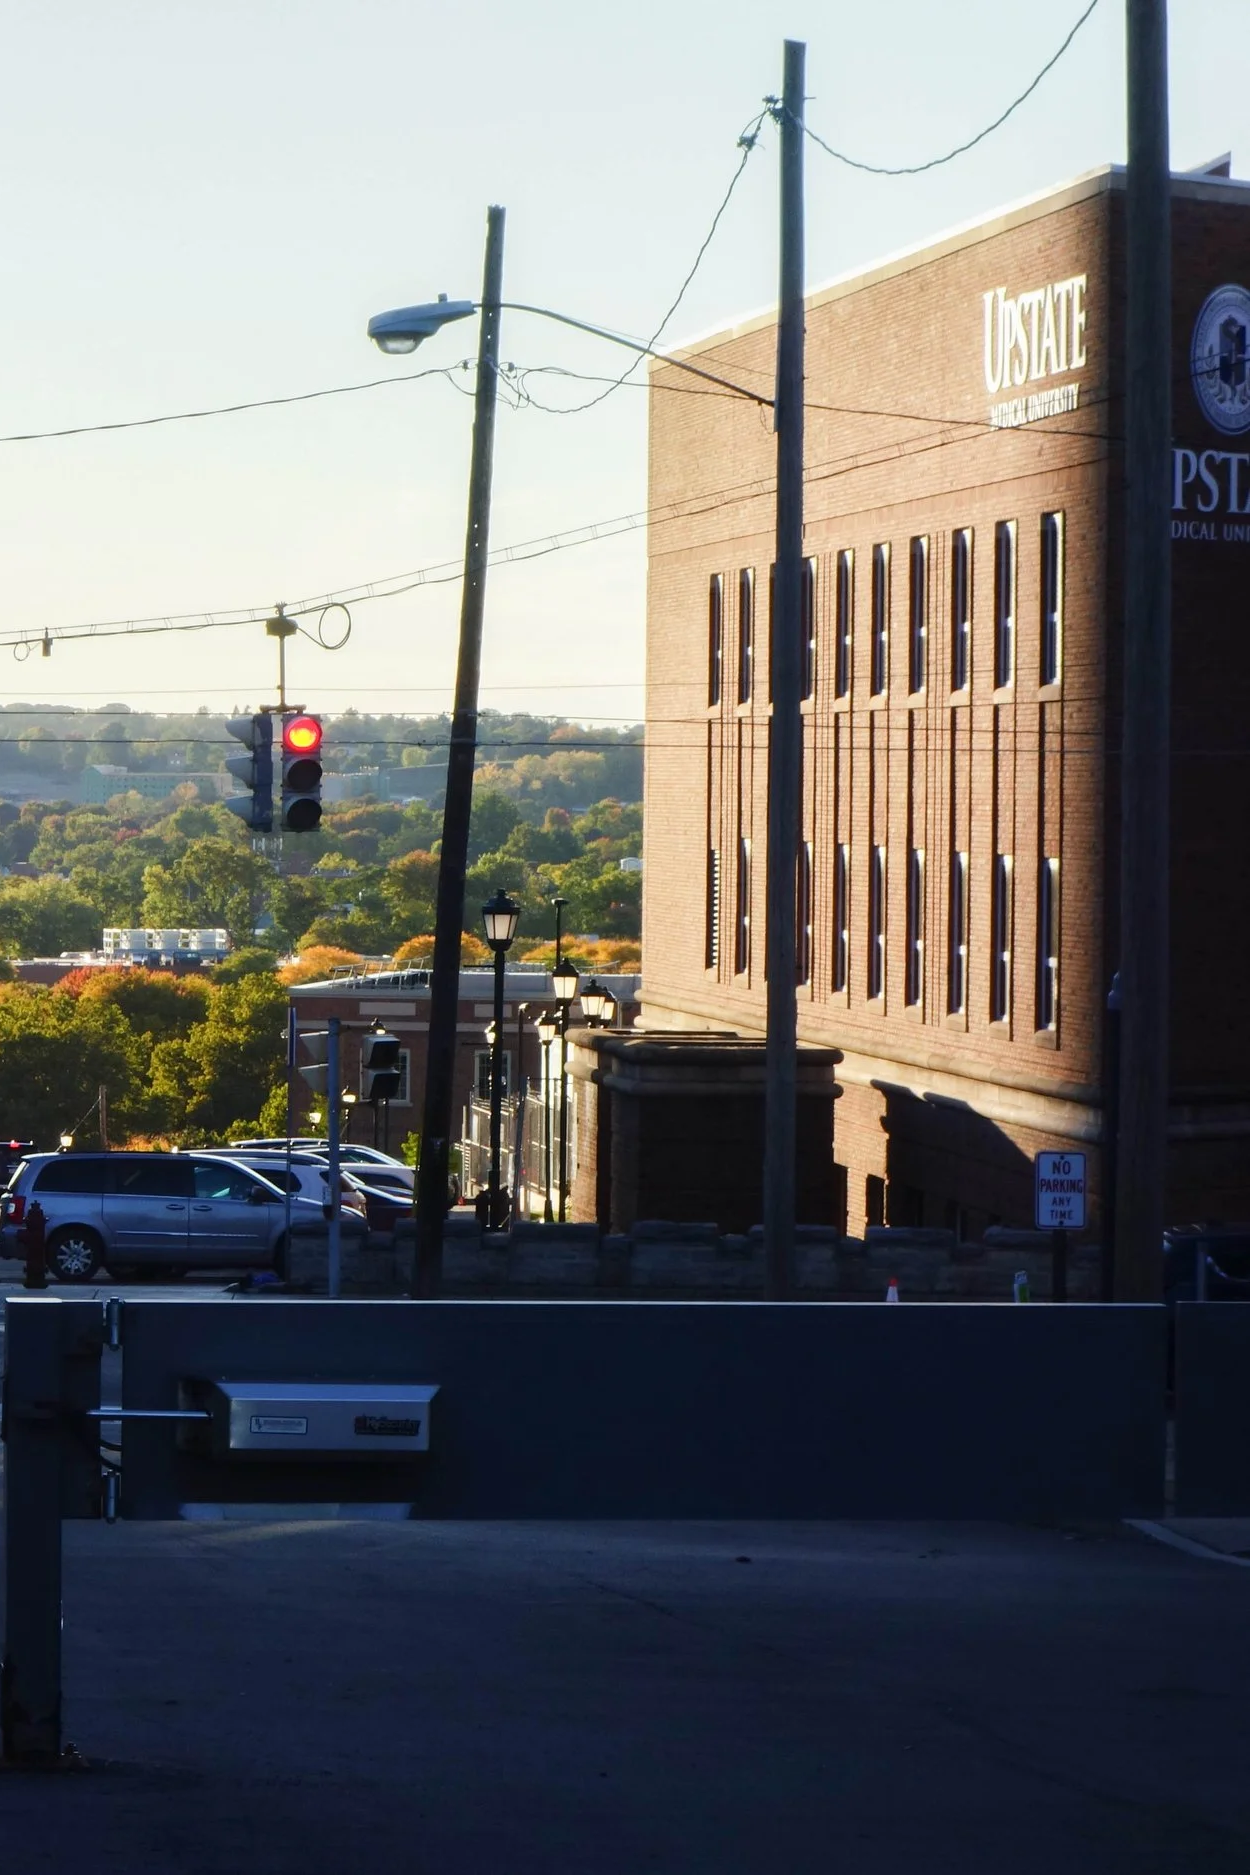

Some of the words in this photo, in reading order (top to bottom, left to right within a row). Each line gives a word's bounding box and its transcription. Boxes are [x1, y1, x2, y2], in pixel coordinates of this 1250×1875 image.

[982, 273, 1087, 394] UPSTATE
[1028, 383, 1080, 422] UNIVERSITY
[1170, 448, 1250, 514] PST
[1171, 519, 1218, 541] DICAL
[1052, 1160, 1072, 1175] NO
[1040, 1178, 1083, 1193] PARKING
[1052, 1196, 1072, 1207] ANY
[1050, 1210, 1075, 1221] TIME
